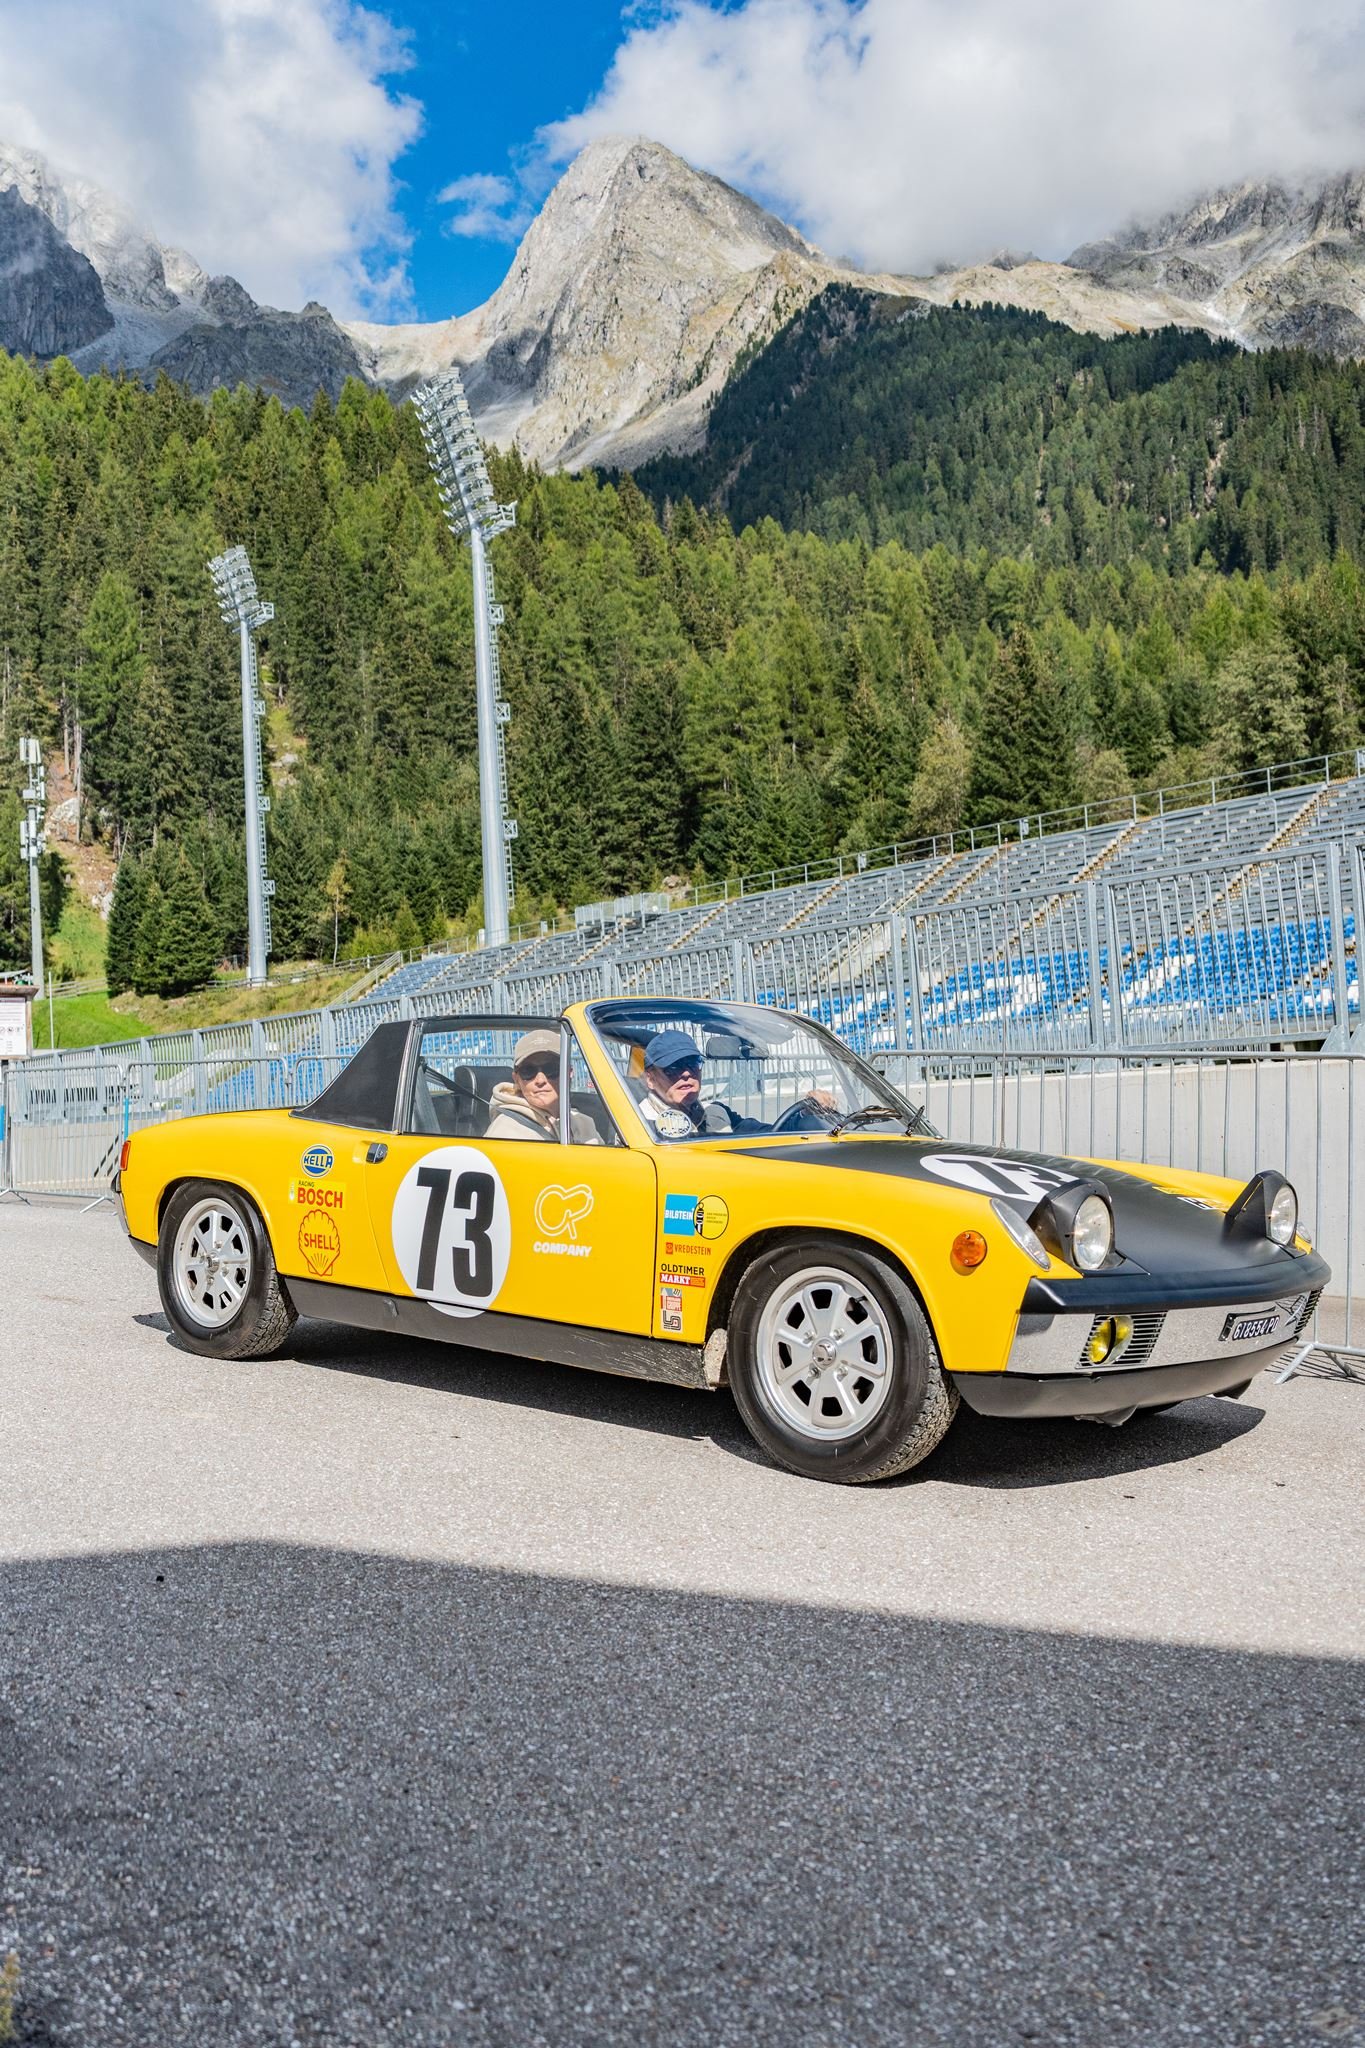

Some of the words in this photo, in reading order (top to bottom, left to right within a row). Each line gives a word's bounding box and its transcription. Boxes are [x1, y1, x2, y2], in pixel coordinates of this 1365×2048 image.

[303, 1155, 334, 1168] HELLA
[297, 1187, 343, 1208] BOSCH
[664, 1209, 694, 1220] BILSTEIN
[416, 1167, 495, 1297] 73
[304, 1232, 335, 1250] SHELL
[533, 1241, 592, 1257] COMPANY
[674, 1244, 711, 1255] VREDESTEIN
[661, 1263, 704, 1275] OLDTIMER
[660, 1274, 690, 1284] MARKT
